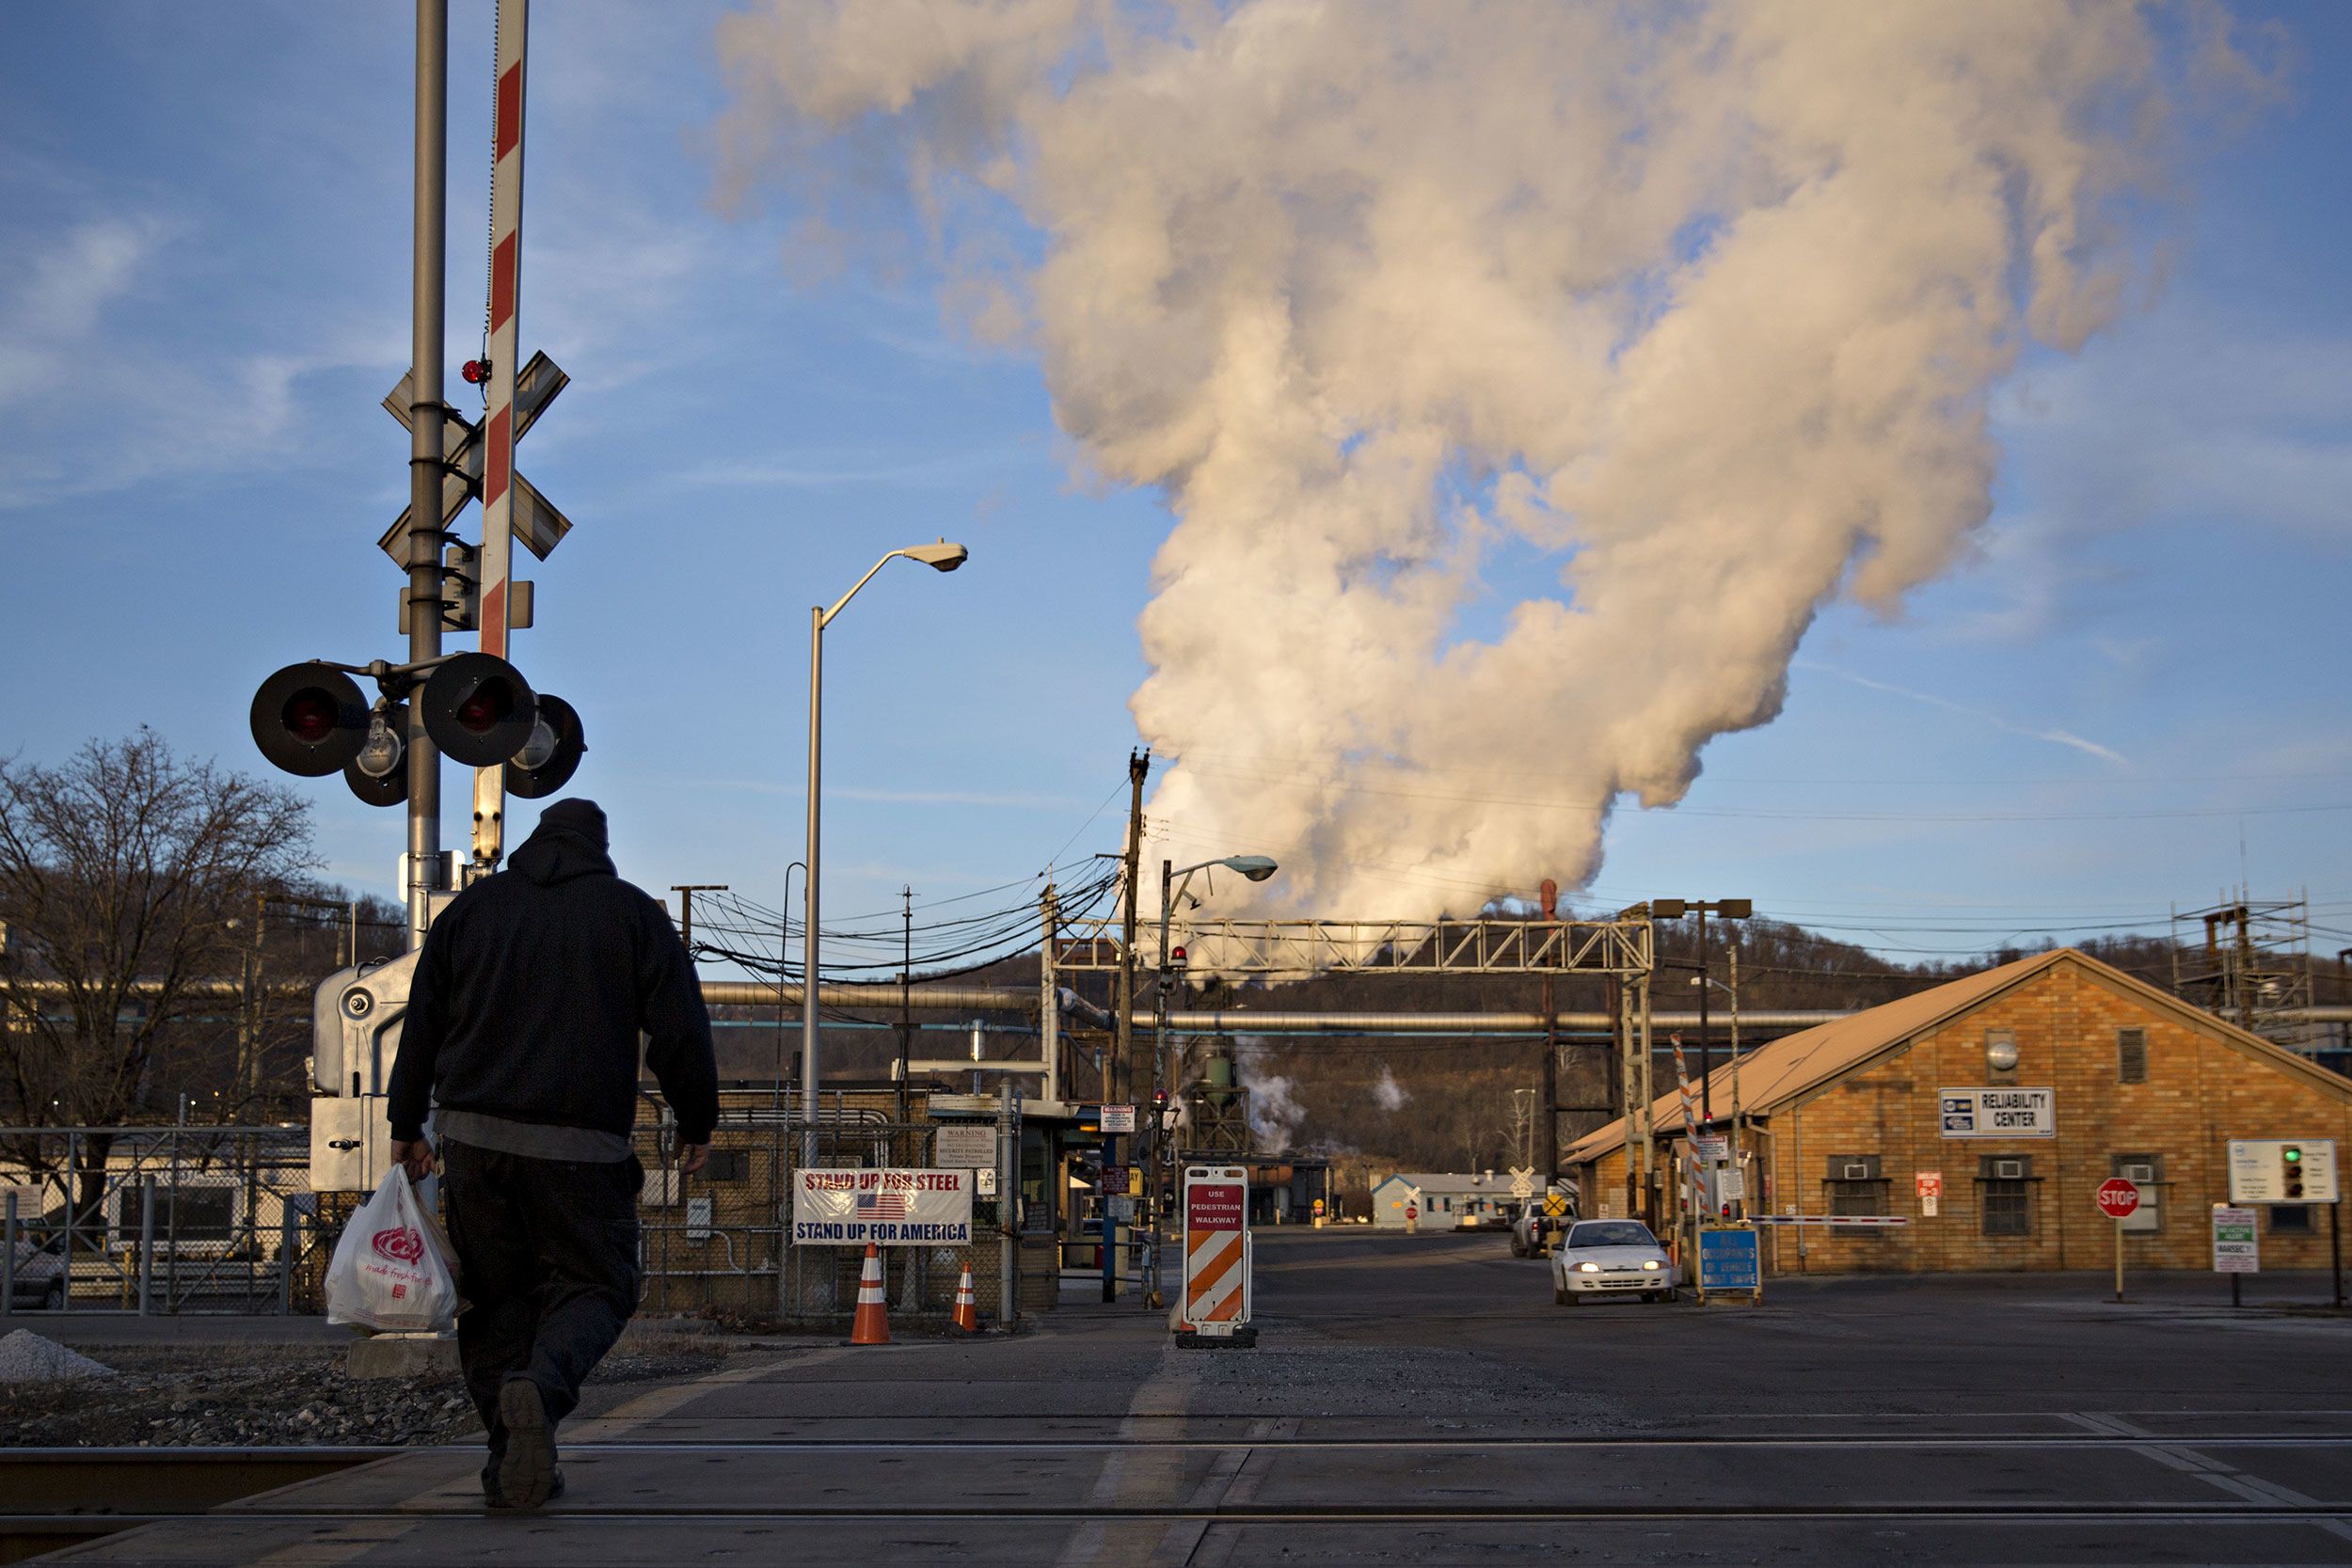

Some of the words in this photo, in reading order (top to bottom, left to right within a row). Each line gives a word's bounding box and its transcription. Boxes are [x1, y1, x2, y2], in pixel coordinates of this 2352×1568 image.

[1981, 1094, 2046, 1109] RELIABILITY
[1994, 1112, 2036, 1126] CENTER
[805, 1173, 855, 1191] STAND
[859, 1173, 881, 1190] UP
[883, 1173, 914, 1191] FOR
[915, 1174, 961, 1191] STEEL
[1129, 1172, 1139, 1181] AY
[2099, 1190, 2137, 1205] STOP
[797, 1223, 843, 1240] STAND
[847, 1223, 867, 1240] UP
[870, 1224, 897, 1240] FOR
[899, 1223, 968, 1240] AMERICA
[390, 1268, 409, 1281] fresh
